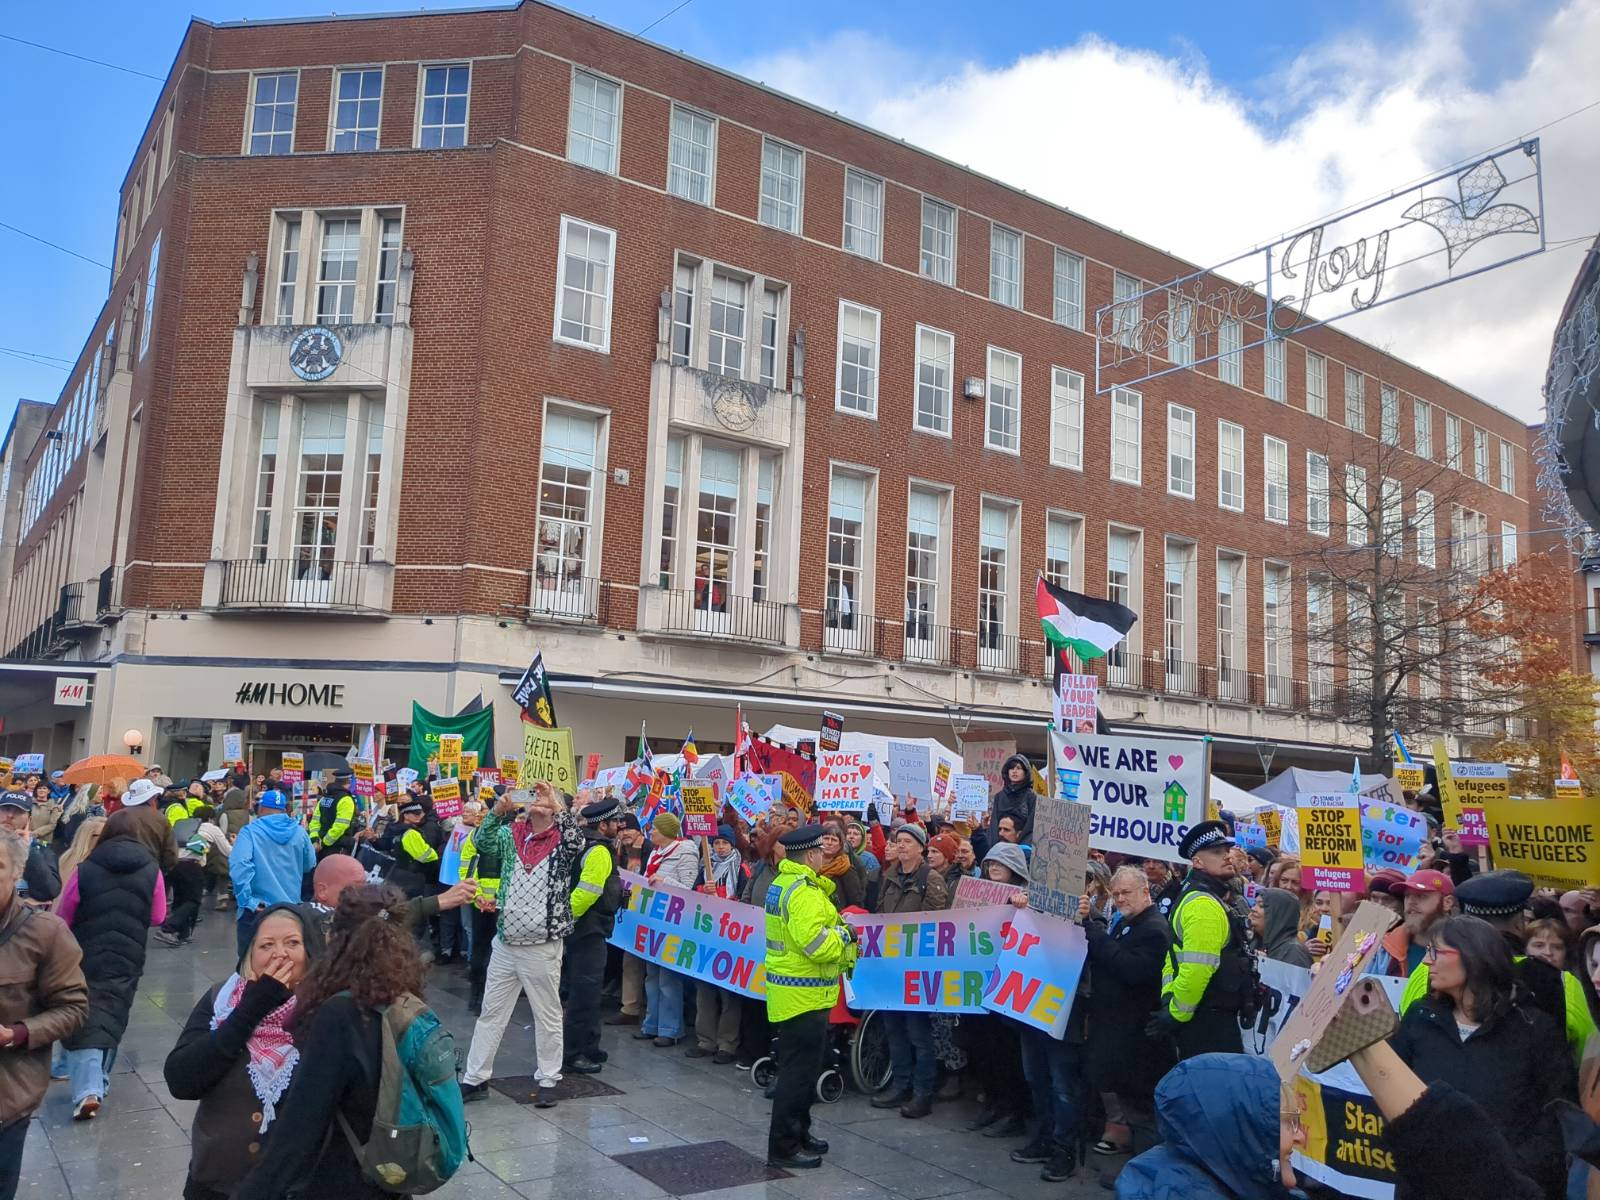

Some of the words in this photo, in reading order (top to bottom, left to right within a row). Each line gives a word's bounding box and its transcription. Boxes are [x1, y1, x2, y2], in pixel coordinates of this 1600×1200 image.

[1269, 226, 1390, 338] Joy
[60, 685, 84, 698] H&M
[269, 683, 345, 707] HOME
[1062, 689, 1094, 705] YOUR
[1061, 704, 1096, 719] LEADER
[525, 735, 559, 761] EXETER
[824, 754, 860, 767] WOKE
[1078, 745, 1110, 769] WE
[1115, 748, 1158, 773] ARE
[829, 773, 858, 783] NOT
[7, 793, 27, 801] POLICE
[683, 788, 699, 797] STOP
[822, 787, 859, 799] HATE
[1089, 779, 1149, 808] YOUR
[686, 805, 713, 813] ATTACKS
[1259, 811, 1273, 819] STOP
[1311, 809, 1344, 823] STOP
[1360, 803, 1420, 828] xeter
[693, 822, 711, 831] FIGHT
[1089, 813, 1188, 847] GHBOURS
[1306, 823, 1352, 837] RACIST
[1495, 824, 1502, 839] I
[1506, 824, 1595, 844] WELCOME
[1305, 837, 1356, 852] REFORM
[1378, 829, 1404, 846] for
[1322, 852, 1341, 865] UK
[1498, 841, 1588, 863] REFUGEES
[1314, 868, 1351, 881] Refugees
[1316, 879, 1350, 889] welcome
[693, 904, 713, 933] is
[719, 912, 754, 945] for
[968, 922, 994, 956] is
[635, 924, 766, 994] EVERYONE
